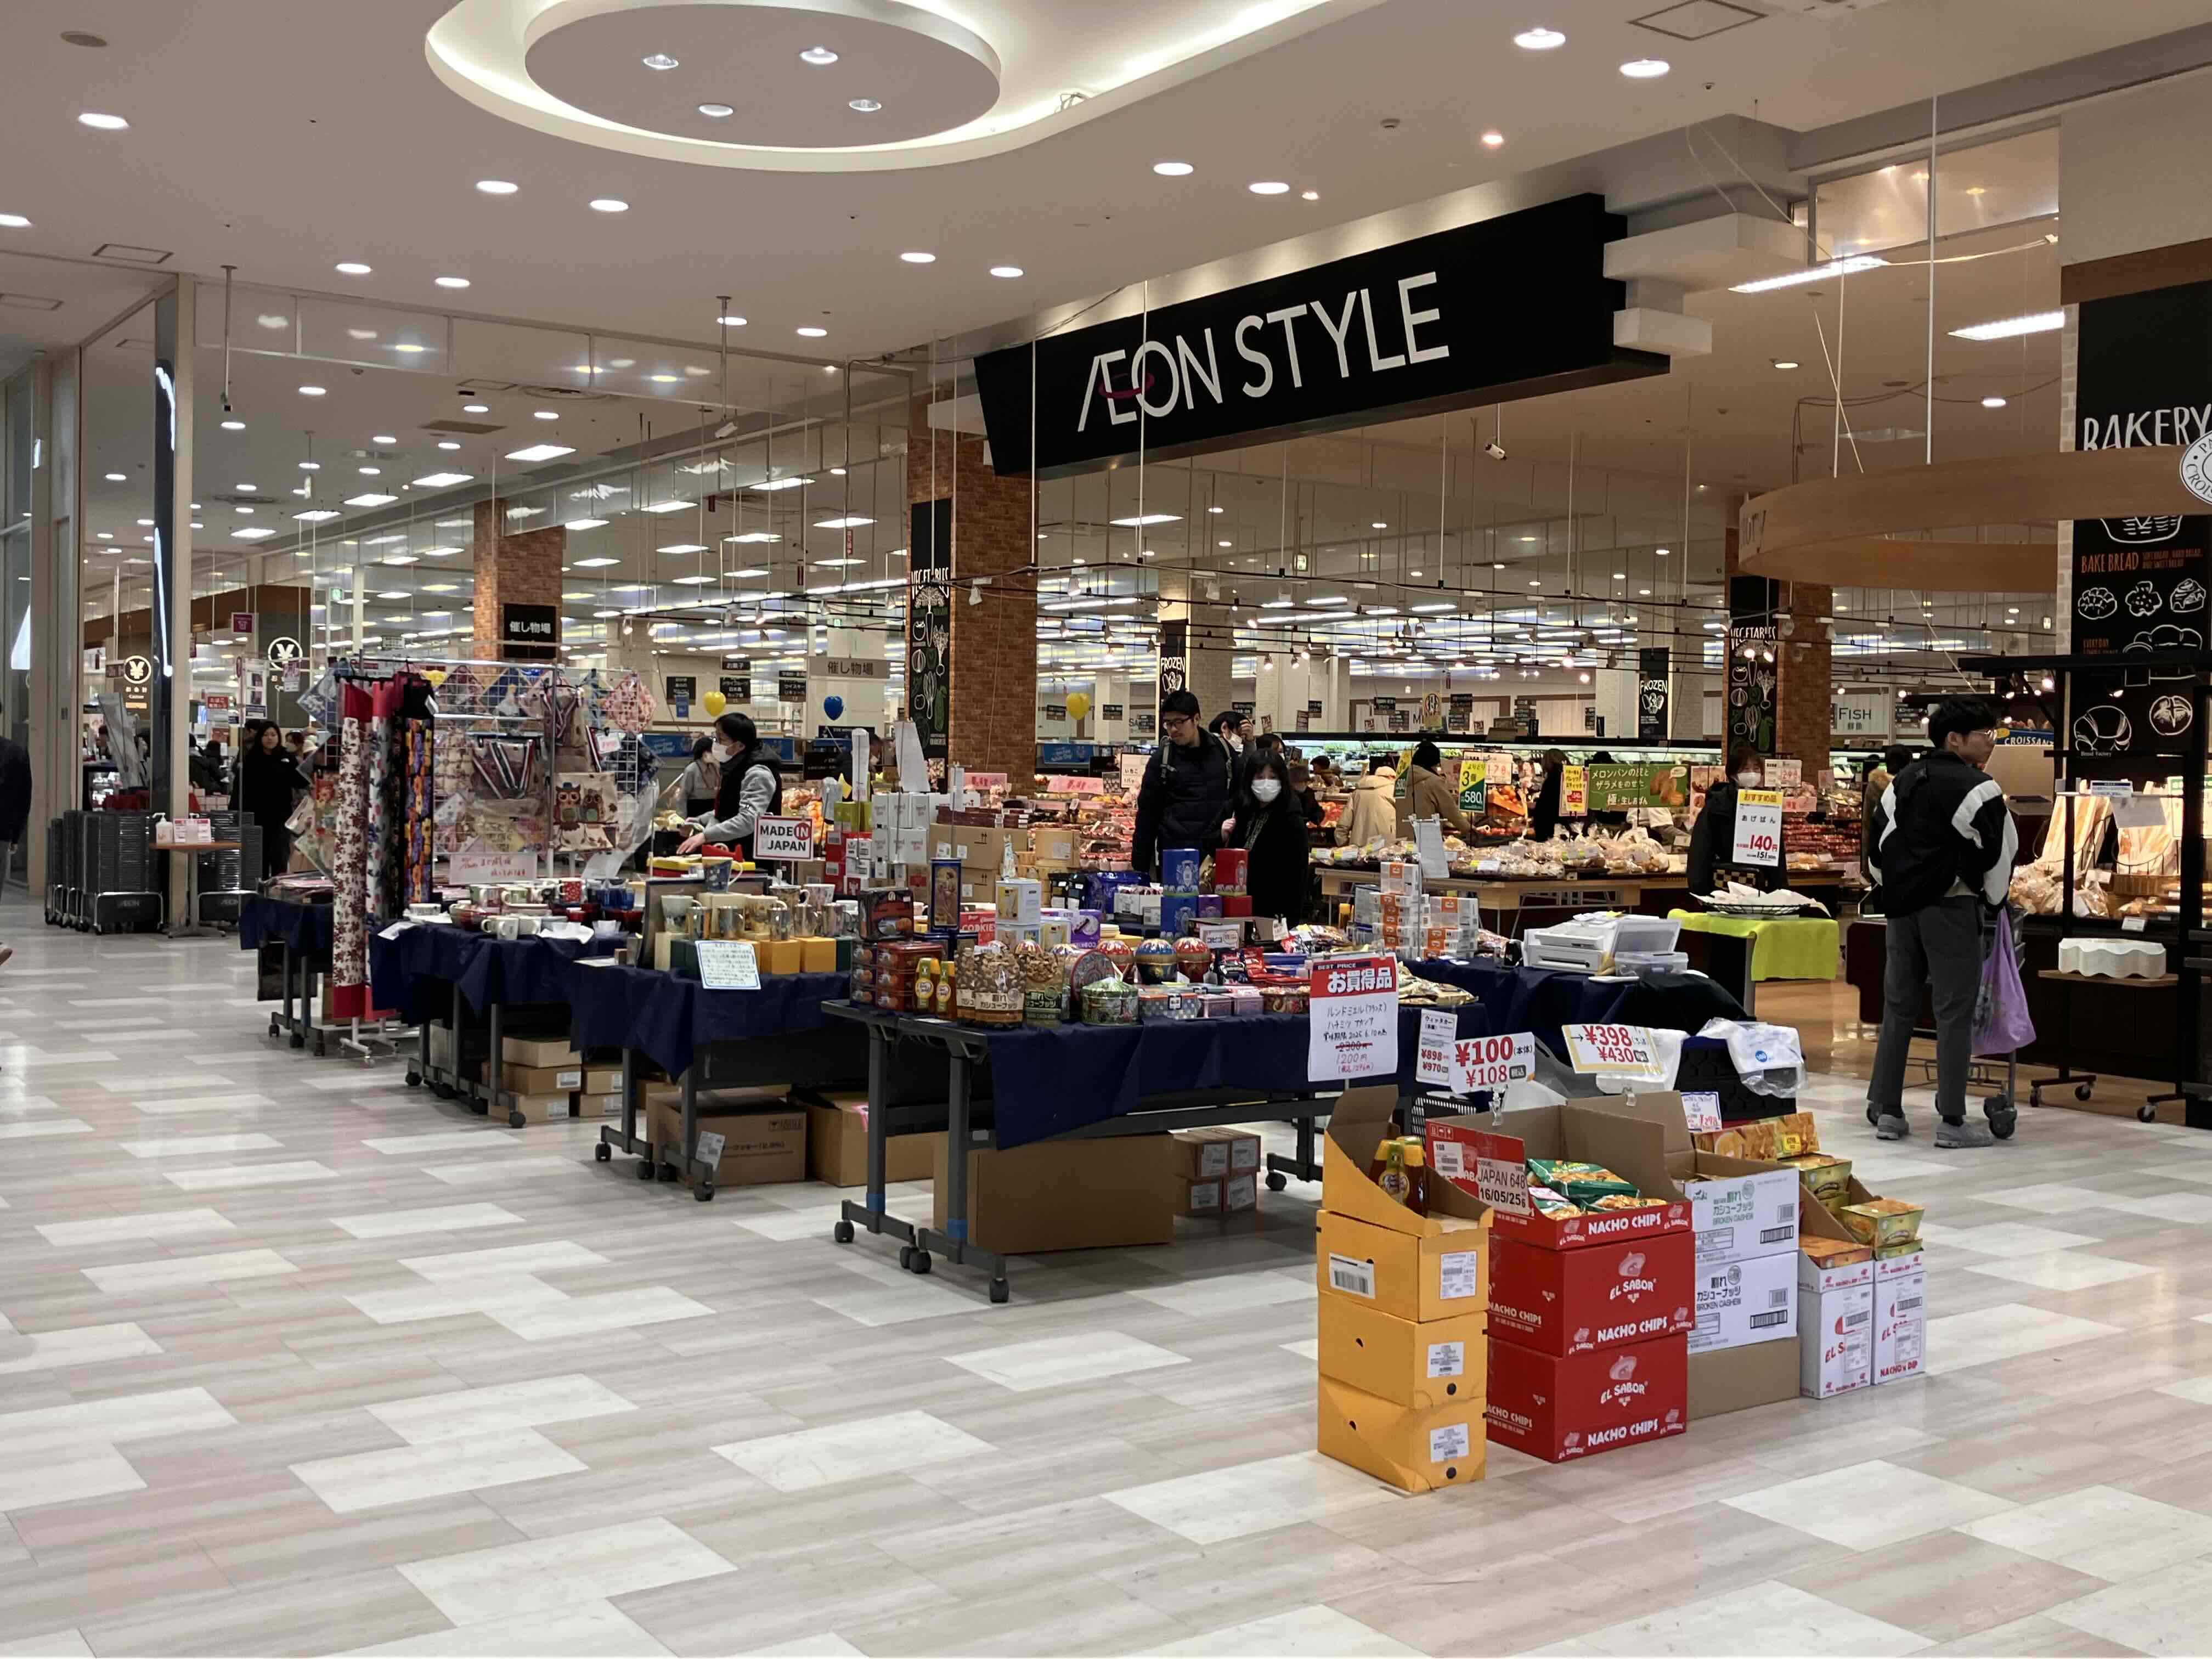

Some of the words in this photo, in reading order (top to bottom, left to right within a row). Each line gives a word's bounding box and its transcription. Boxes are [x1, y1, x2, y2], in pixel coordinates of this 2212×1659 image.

[1234, 271, 1449, 398] STYLE
[2084, 404, 2212, 451] BAKERY
[2081, 553, 2106, 573] BAKE
[2108, 552, 2139, 572] BREAD
[509, 621, 551, 634] 催し物場
[827, 661, 874, 676] 催し物場
[1160, 656, 1186, 674] FROZEN
[1640, 680, 1668, 695] FROZEN
[1839, 707, 1871, 720] FISH
[760, 825, 793, 837] MADE
[795, 826, 809, 838] IN
[768, 840, 806, 851] JAPAN
[1327, 966, 1393, 994] お買得品
[1582, 1025, 1633, 1046] ¥398
[1421, 1048, 1443, 1061] ¥898
[1454, 1036, 1514, 1067] ¥100
[1514, 1045, 1533, 1056] (本体)
[1597, 1046, 1634, 1063] ¥430
[1422, 1062, 1441, 1073] ¥970
[1465, 1064, 1508, 1087] ¥108
[1478, 1168, 1508, 1186] JAPAN
[1510, 1172, 1526, 1189] 648
[1480, 1188, 1521, 1206] 16/05/25
[1588, 1217, 1629, 1235] NACHO
[1632, 1212, 1661, 1228] CHIPS
[1712, 1216, 1733, 1226] BROKEN
[1610, 1285, 1622, 1300] EL
[1623, 1279, 1654, 1292] SABOR
[1488, 1301, 1517, 1317] NACHO
[1519, 1310, 1542, 1325] CHIPS
[1696, 1301, 1718, 1311] BROKEN
[1719, 1297, 1742, 1309] CASHEW
[1598, 1323, 1637, 1342] NACHO
[1639, 1316, 1667, 1333] CHIPS
[1882, 1328, 1891, 1341] EL
[1825, 1347, 1836, 1363] EL
[1880, 1364, 1902, 1377] NACHO
[1907, 1360, 1918, 1370] DIP
[1600, 1393, 1612, 1404] EL
[1613, 1383, 1646, 1396] SABOR
[1486, 1404, 1509, 1419] ACHO
[1510, 1412, 1533, 1428] CHIPS
[1587, 1426, 1627, 1447] NACHO
[1630, 1419, 1660, 1436] CHIPS
